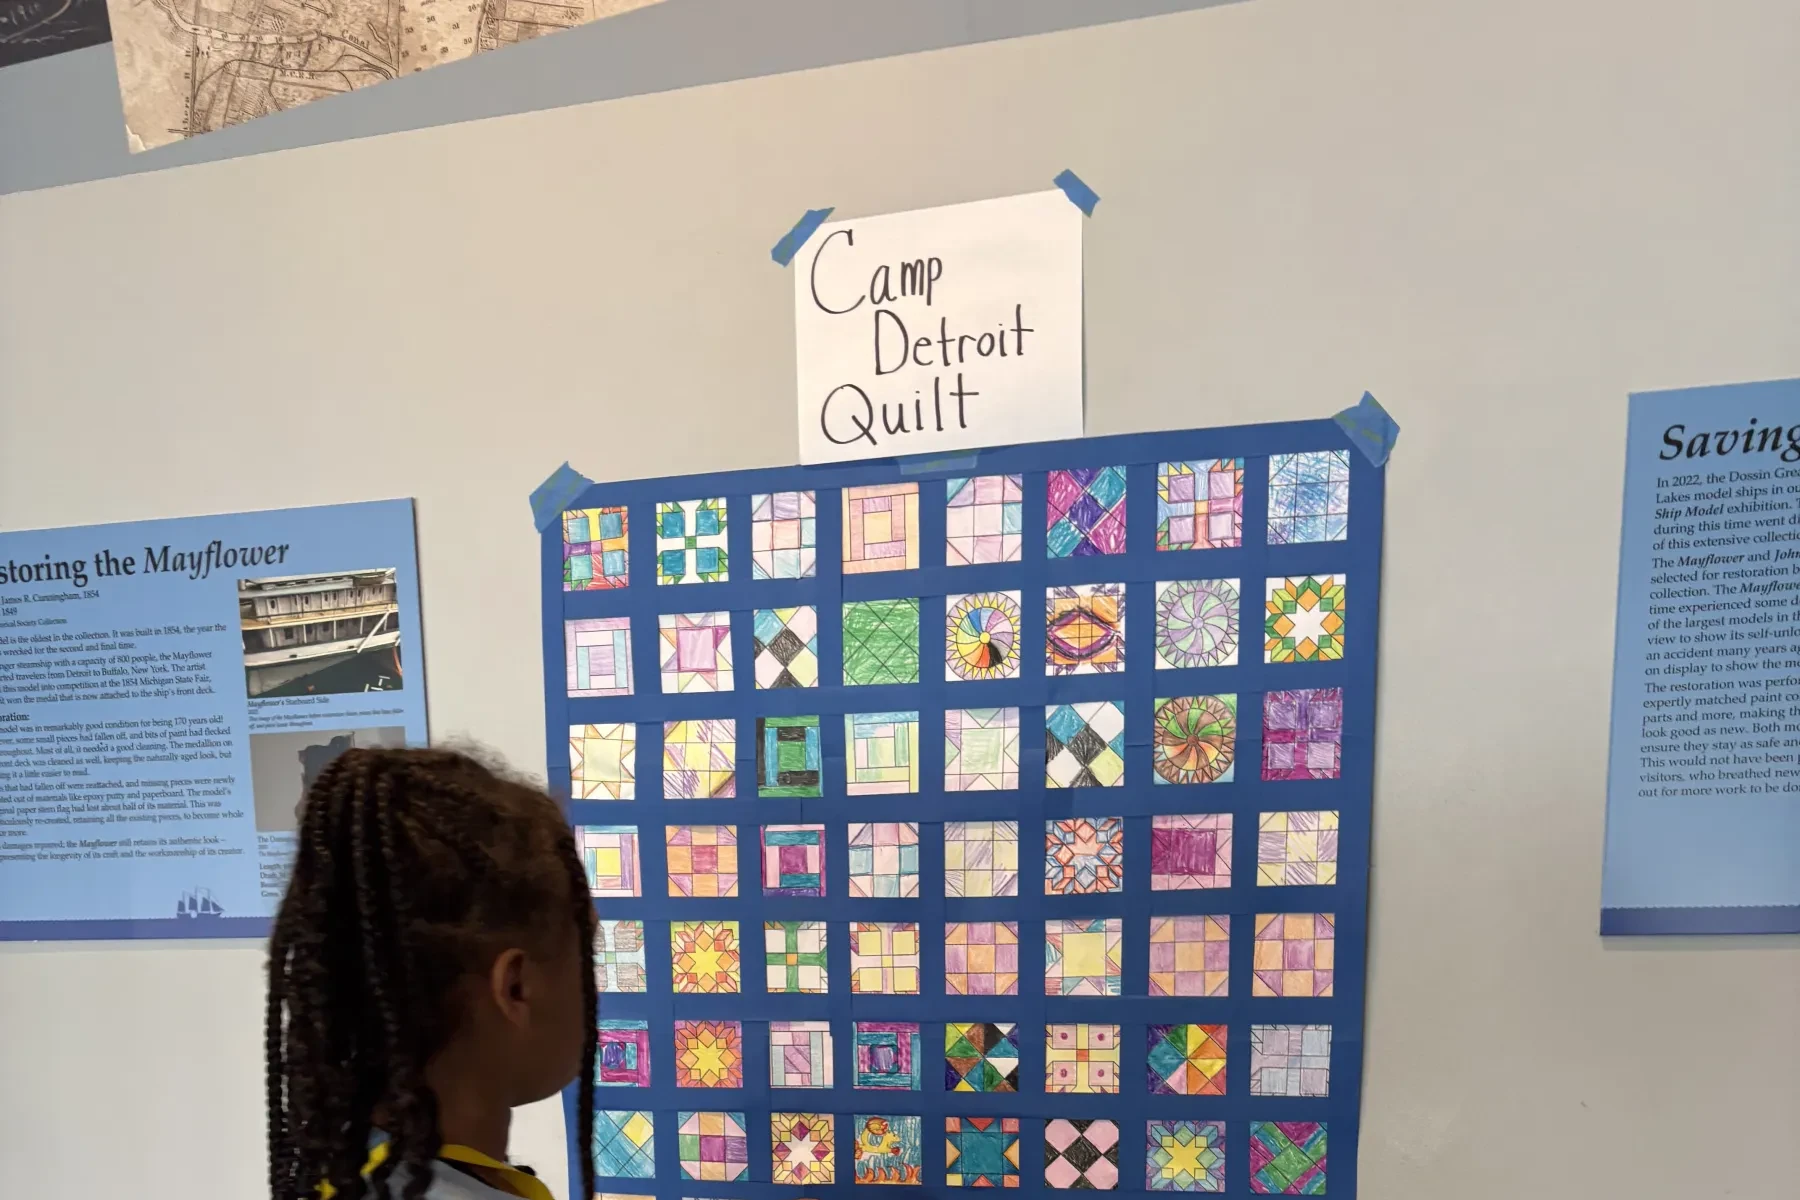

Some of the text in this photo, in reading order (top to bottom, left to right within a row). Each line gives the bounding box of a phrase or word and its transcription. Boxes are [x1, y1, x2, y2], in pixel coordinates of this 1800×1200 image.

[811, 229, 942, 314] Camp
[875, 304, 1034, 375] Detroit
[821, 373, 979, 445] Quilt
[1656, 478, 1668, 488] In
[1672, 475, 1702, 486] 2022,
[1707, 472, 1726, 484] the
[1729, 469, 1770, 481] Dossin
[1656, 485, 1783, 504] Lakes model ships in
[1655, 501, 1792, 520] Ship Model exhibition.
[1654, 516, 1785, 536] during this time went
[1653, 539, 1664, 550] of
[1668, 538, 1690, 549] this
[1694, 534, 1750, 547] extensive
[94, 549, 135, 577] the
[143, 540, 289, 580] Mayflower
[1652, 558, 1674, 568] The
[1678, 554, 1744, 568] Mayflower
[1748, 550, 1770, 562] and
[1651, 566, 1788, 584] selected for restoration
[1650, 587, 1710, 600] collection.
[1714, 584, 1737, 594] The
[1650, 598, 1787, 615] time experienced some
[1648, 612, 1788, 630] of the largest models in
[1648, 635, 1677, 645] view
[1680, 634, 1691, 644] to
[1695, 631, 1726, 642] show
[1731, 630, 1744, 640] its
[1646, 644, 1787, 660] an accident many years
[1664, 662, 1707, 676] display
[1712, 662, 1722, 672] to
[1726, 660, 1758, 672] show
[1762, 659, 1781, 669] the
[1645, 683, 1666, 693] The
[1670, 680, 1734, 692] restoration
[1738, 679, 1762, 688] was
[1643, 692, 1782, 710] expertly matched paint
[1643, 714, 1672, 726] parts
[1676, 711, 1697, 721] and
[1702, 712, 1735, 720] more,
[1740, 708, 1785, 721] making
[1642, 722, 1780, 740] look good as new. Both
[1640, 744, 1680, 753] ensure
[1683, 741, 1709, 753] they
[1712, 741, 1736, 753] stay
[1756, 737, 1780, 747] safe
[1640, 753, 1793, 768] This would not have been
[1689, 770, 1714, 780] who
[1719, 768, 1771, 779] breathed
[1638, 783, 1779, 797] out for more work to be
